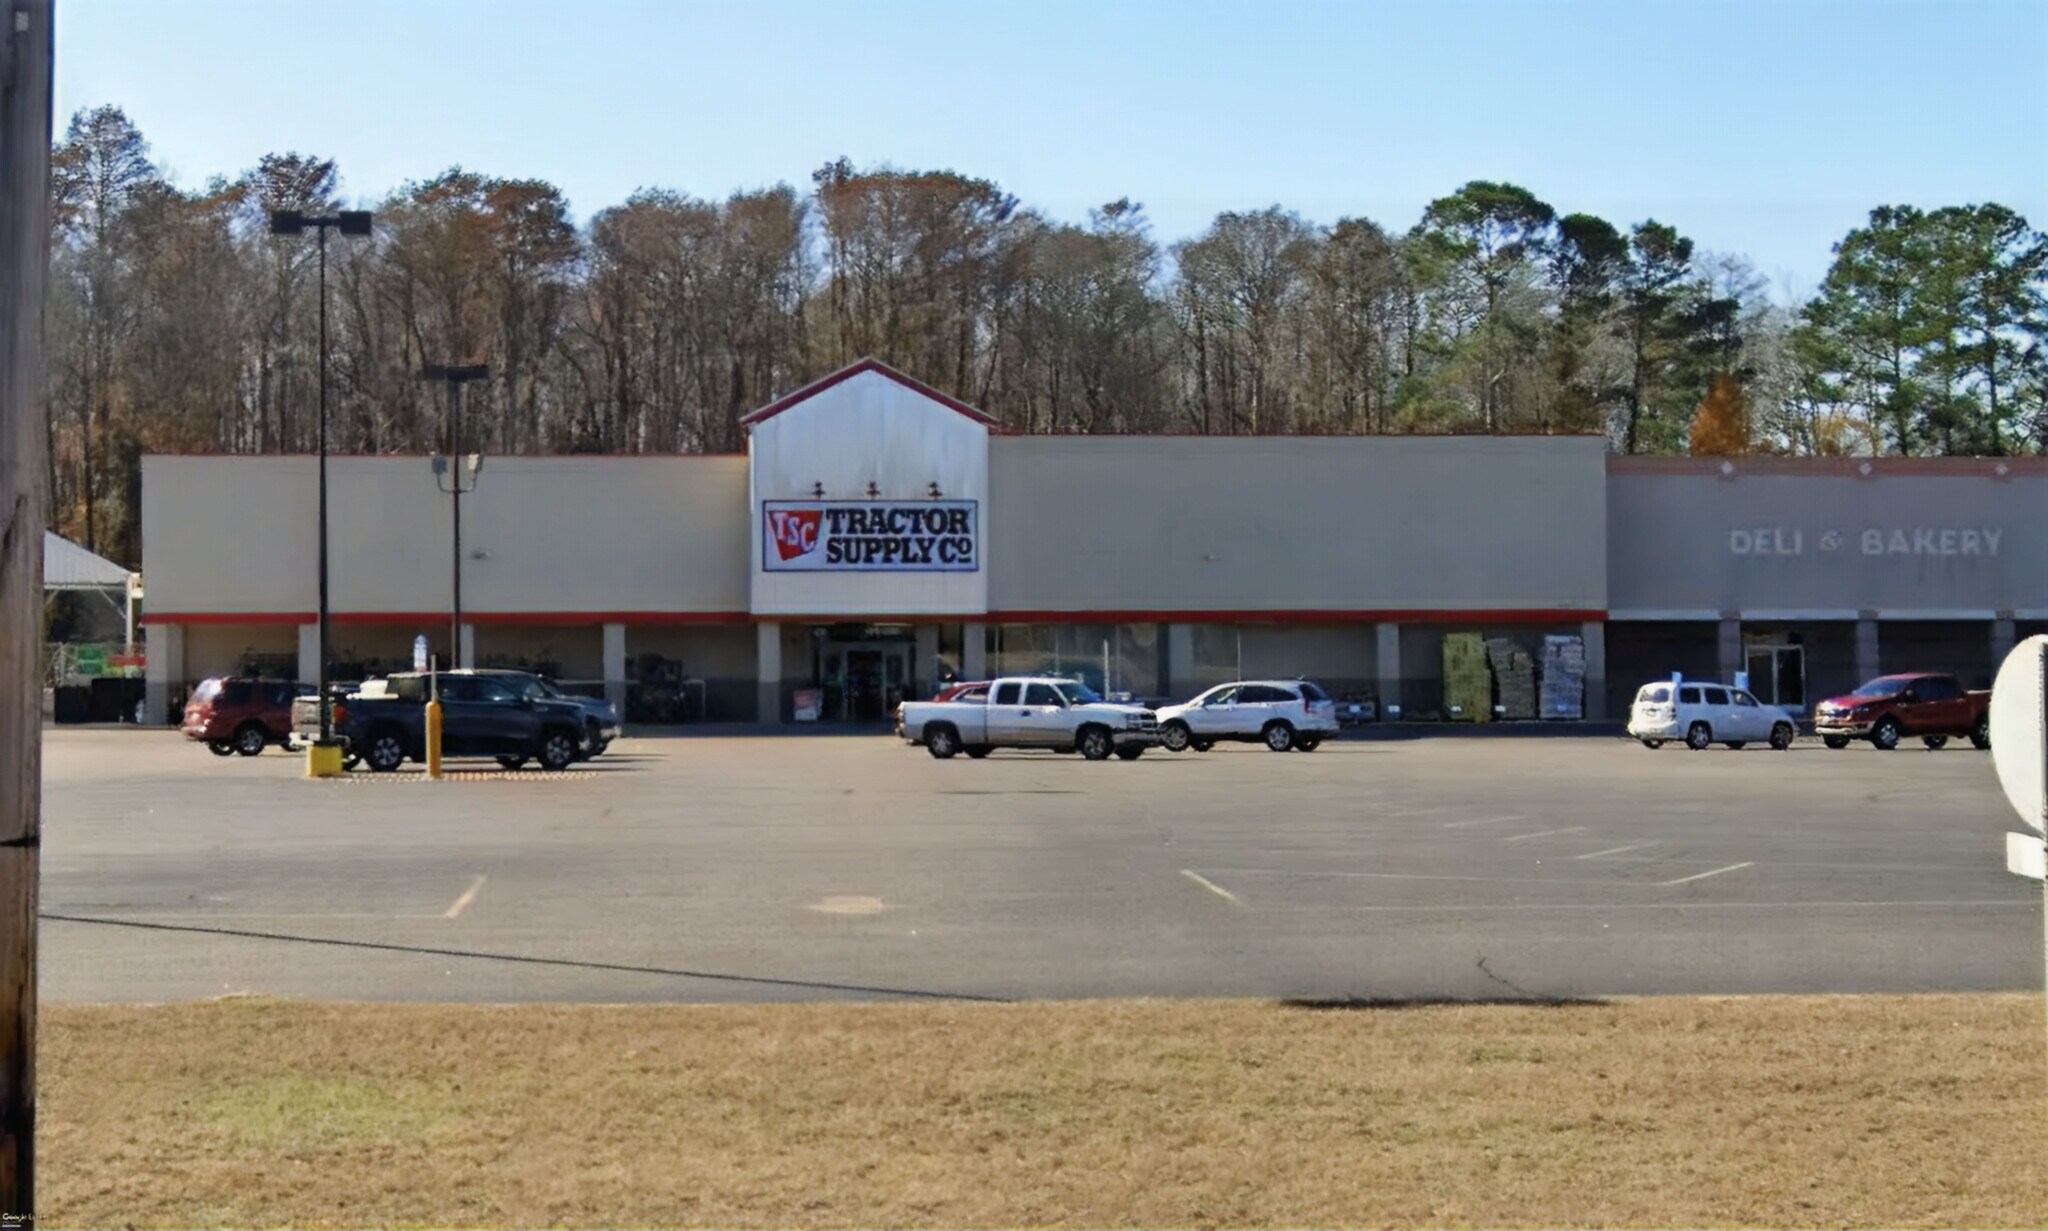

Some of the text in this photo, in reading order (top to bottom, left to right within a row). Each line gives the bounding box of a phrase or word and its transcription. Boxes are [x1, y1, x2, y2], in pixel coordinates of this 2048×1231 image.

[772, 512, 815, 552] TSC
[826, 508, 970, 534] TRACTOR
[826, 537, 936, 564] SUPPLY
[1730, 528, 2003, 556] DELI & BAKERY
